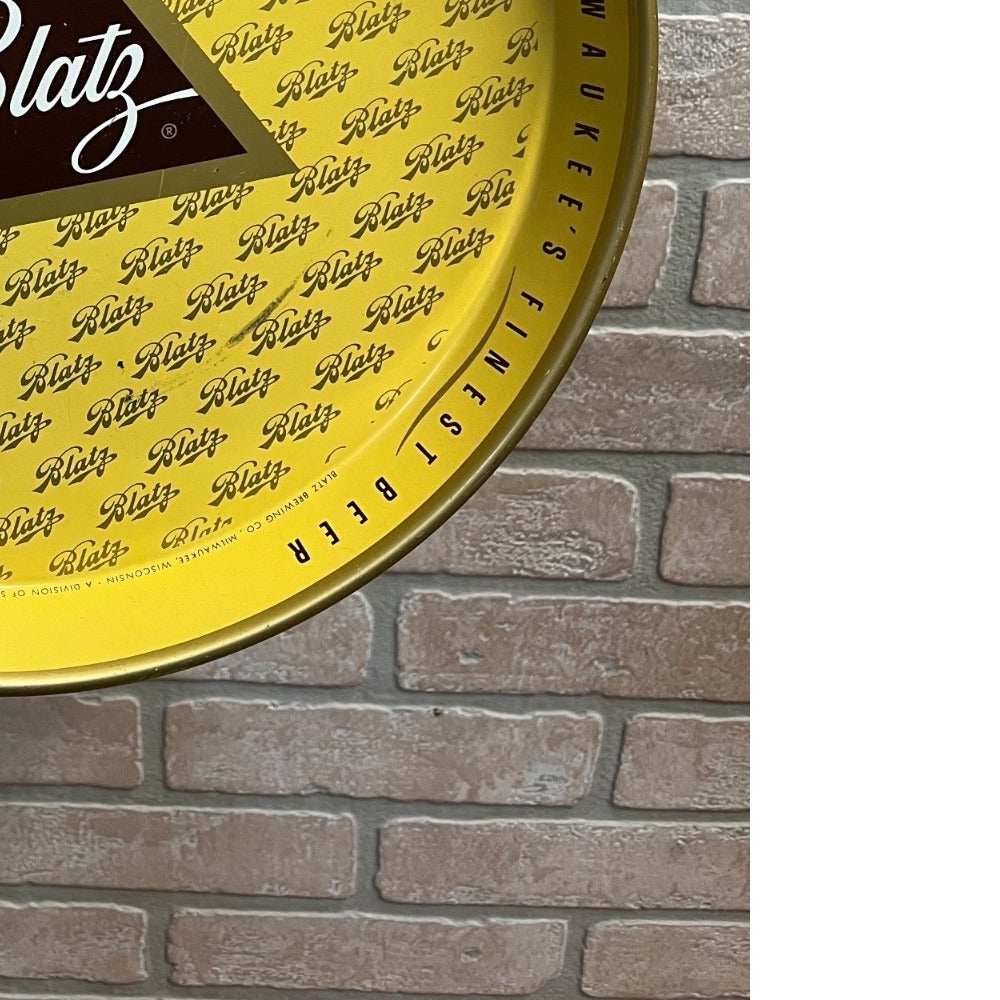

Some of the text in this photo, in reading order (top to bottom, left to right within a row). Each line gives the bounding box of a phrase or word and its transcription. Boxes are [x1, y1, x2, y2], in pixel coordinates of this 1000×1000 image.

[211, 22, 294, 64] Blatz
[325, 1, 411, 49] Blatz
[273, 60, 359, 108] Blatz
[389, 38, 474, 86] Blatz
[337, 97, 422, 146] Blatz
[451, 76, 534, 123] Blatz
[287, 155, 371, 203] Blatz
[400, 133, 485, 181] Blatz
[349, 191, 434, 240] Blatz
[462, 169, 515, 217] Bla
[117, 237, 204, 285] Blatz
[235, 213, 320, 262] Blatz
[412, 227, 495, 275] Blatz
[1, 258, 88, 307] Blatz
[183, 272, 268, 321] Blatz
[299, 249, 383, 298] Blatz
[68, 294, 154, 343] Blatz
[248, 308, 332, 356] Blatz
[362, 285, 445, 333] Blatz
[17, 353, 103, 401] Blatz
[131, 331, 217, 379] Blatz
[311, 343, 395, 391] Blatz
[415, 290, 545, 466] FINEST
[83, 388, 168, 436] Blatz
[195, 367, 281, 415] Blatz
[258, 402, 341, 450] Blatz
[32, 446, 118, 494] Blatz
[144, 427, 229, 475] Blatz
[208, 460, 291, 507] Blatz
[313, 470, 338, 493] BLATZ
[96, 482, 181, 530] Blatz
[265, 493, 310, 524] BREWING
[287, 475, 398, 564] BEER
[49, 539, 130, 577] Blatz
[106, 562, 172, 584] WISCONSIN
[12, 589, 26, 598] OF
[31, 583, 82, 597] DIVISION
[85, 580, 93, 589] A
